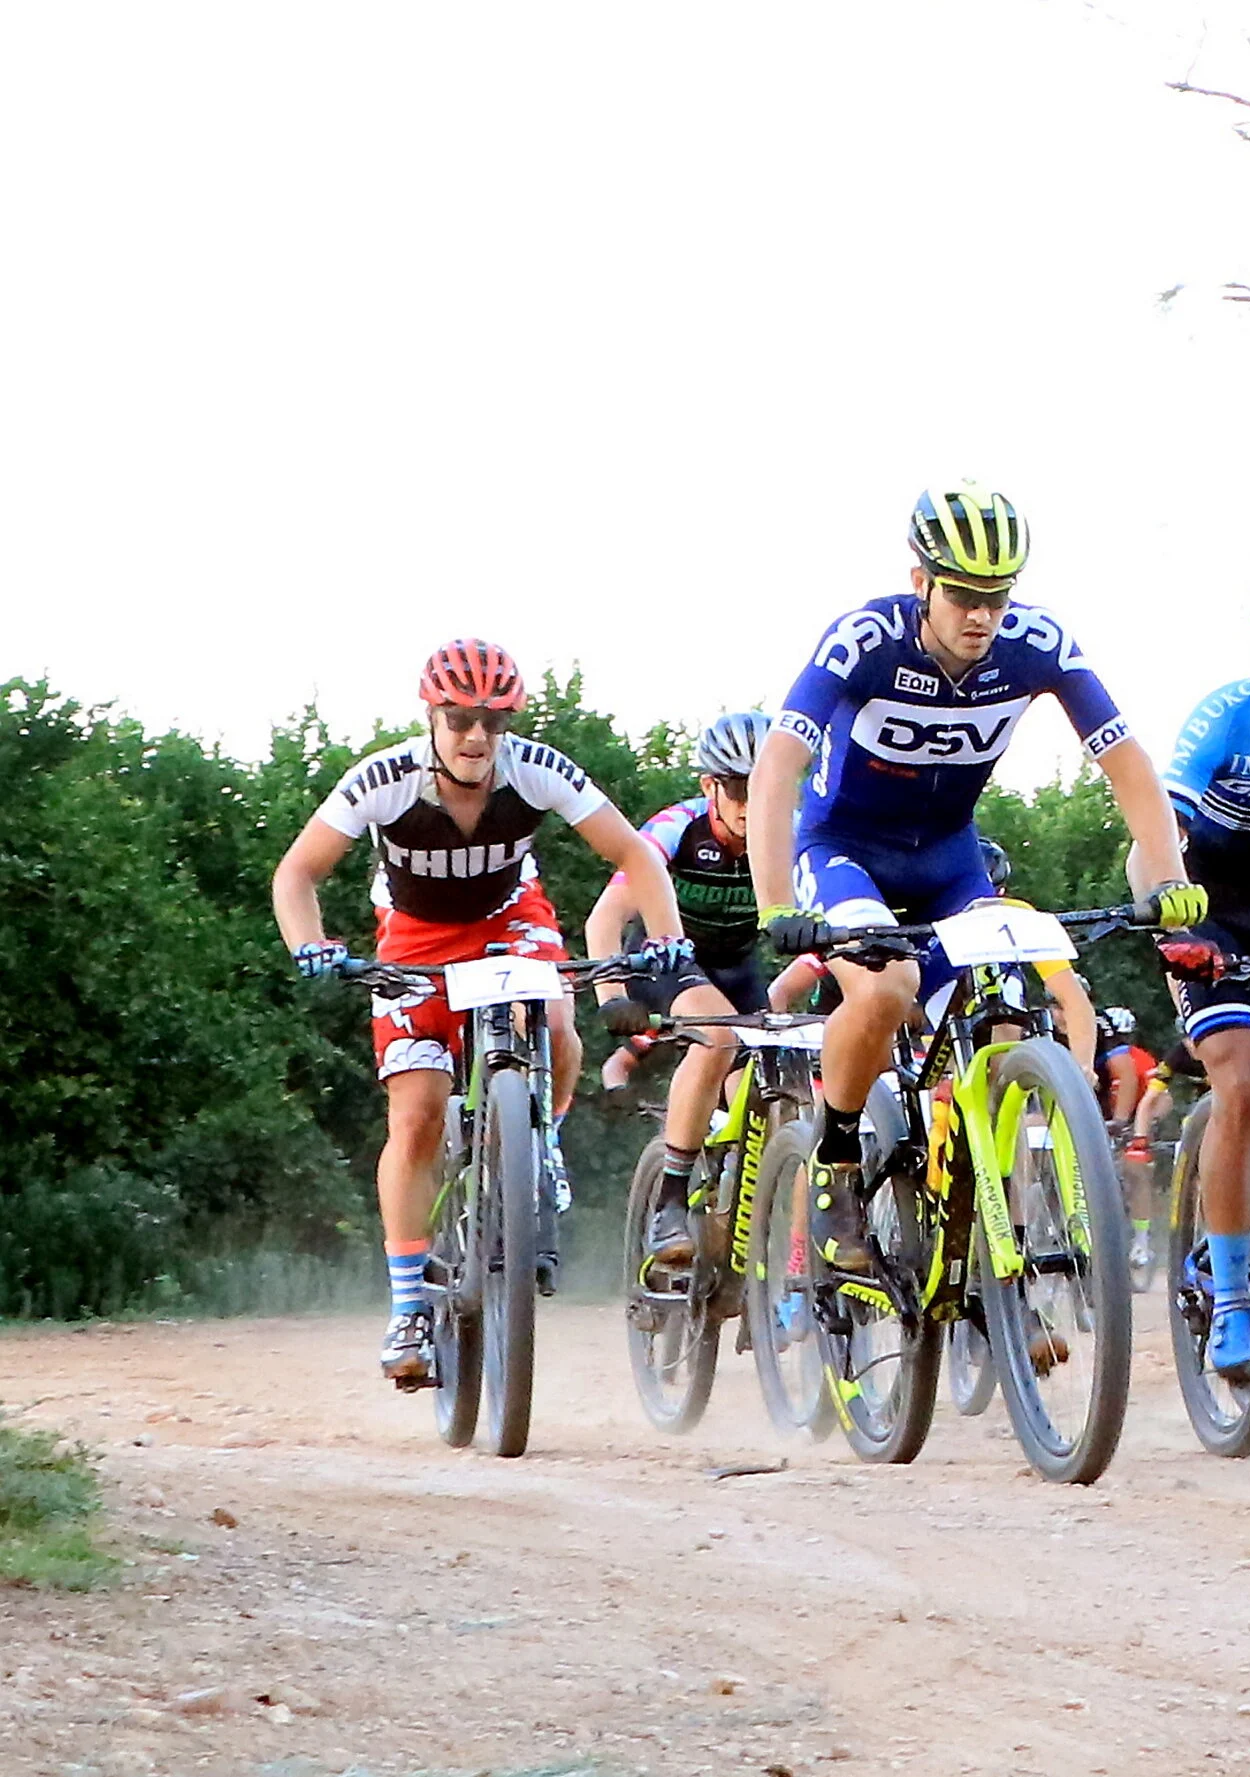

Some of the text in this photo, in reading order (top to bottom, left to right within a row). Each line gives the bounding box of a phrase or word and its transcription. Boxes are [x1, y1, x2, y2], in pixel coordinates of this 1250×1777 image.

[814, 602, 906, 680] DSV
[999, 606, 1096, 672] DSV
[877, 716, 1012, 756] DSV
[998, 923, 1018, 947] 1
[494, 969, 513, 991] 7
